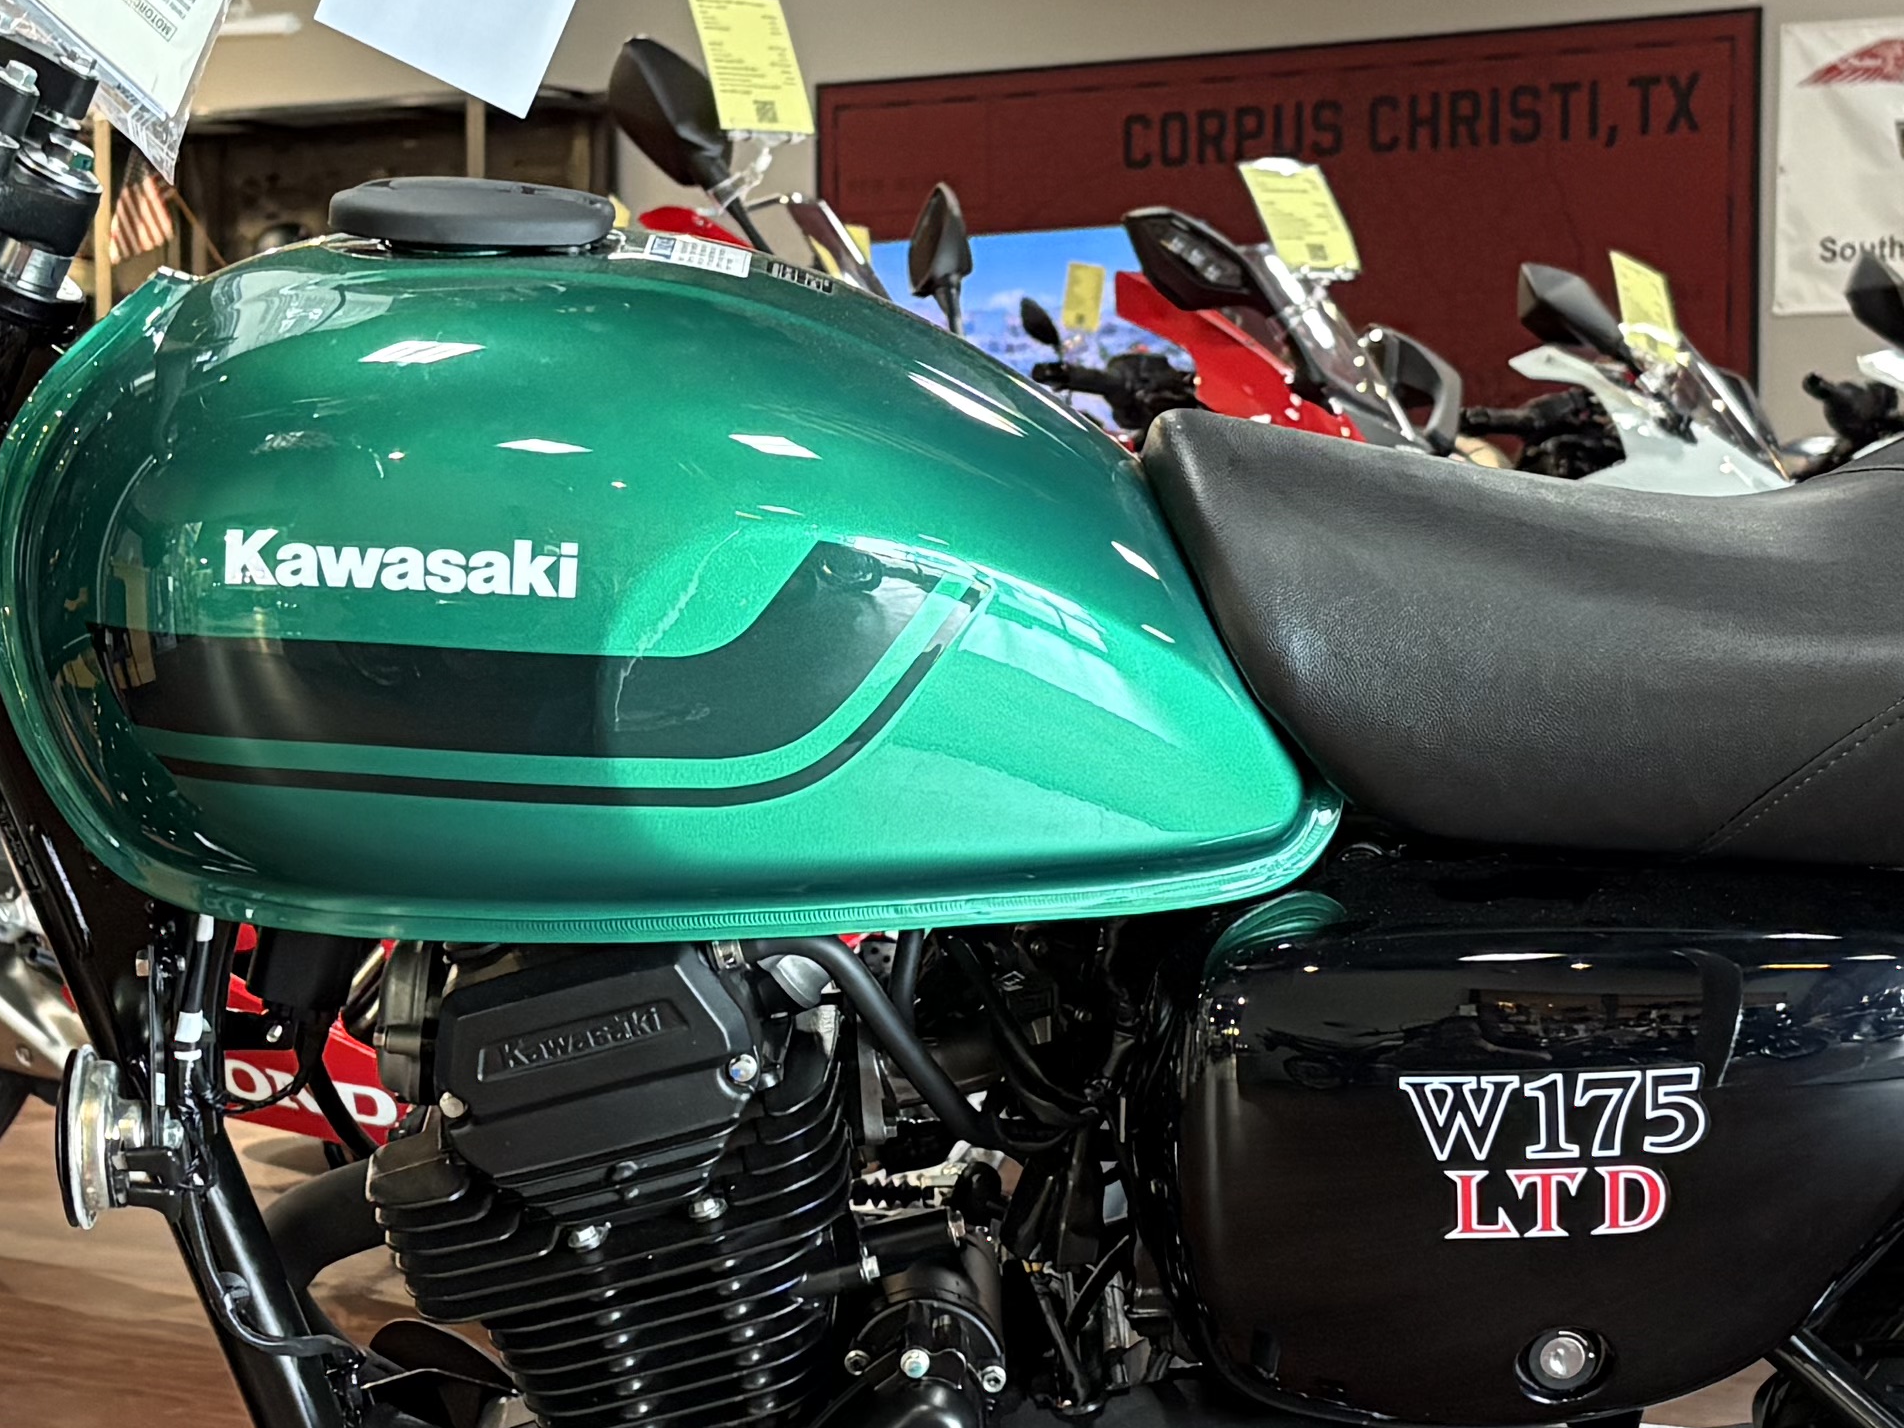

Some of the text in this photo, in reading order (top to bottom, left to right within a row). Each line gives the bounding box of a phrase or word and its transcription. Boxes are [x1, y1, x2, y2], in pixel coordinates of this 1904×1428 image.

[1122, 72, 1700, 170] CORPUS CHRISTI, TX
[1819, 232, 1904, 263] South
[223, 528, 579, 599] Kawasaki
[501, 1006, 662, 1068] Kawasaki
[1399, 1067, 1707, 1162] W175
[1443, 1165, 1671, 1239] LTD
